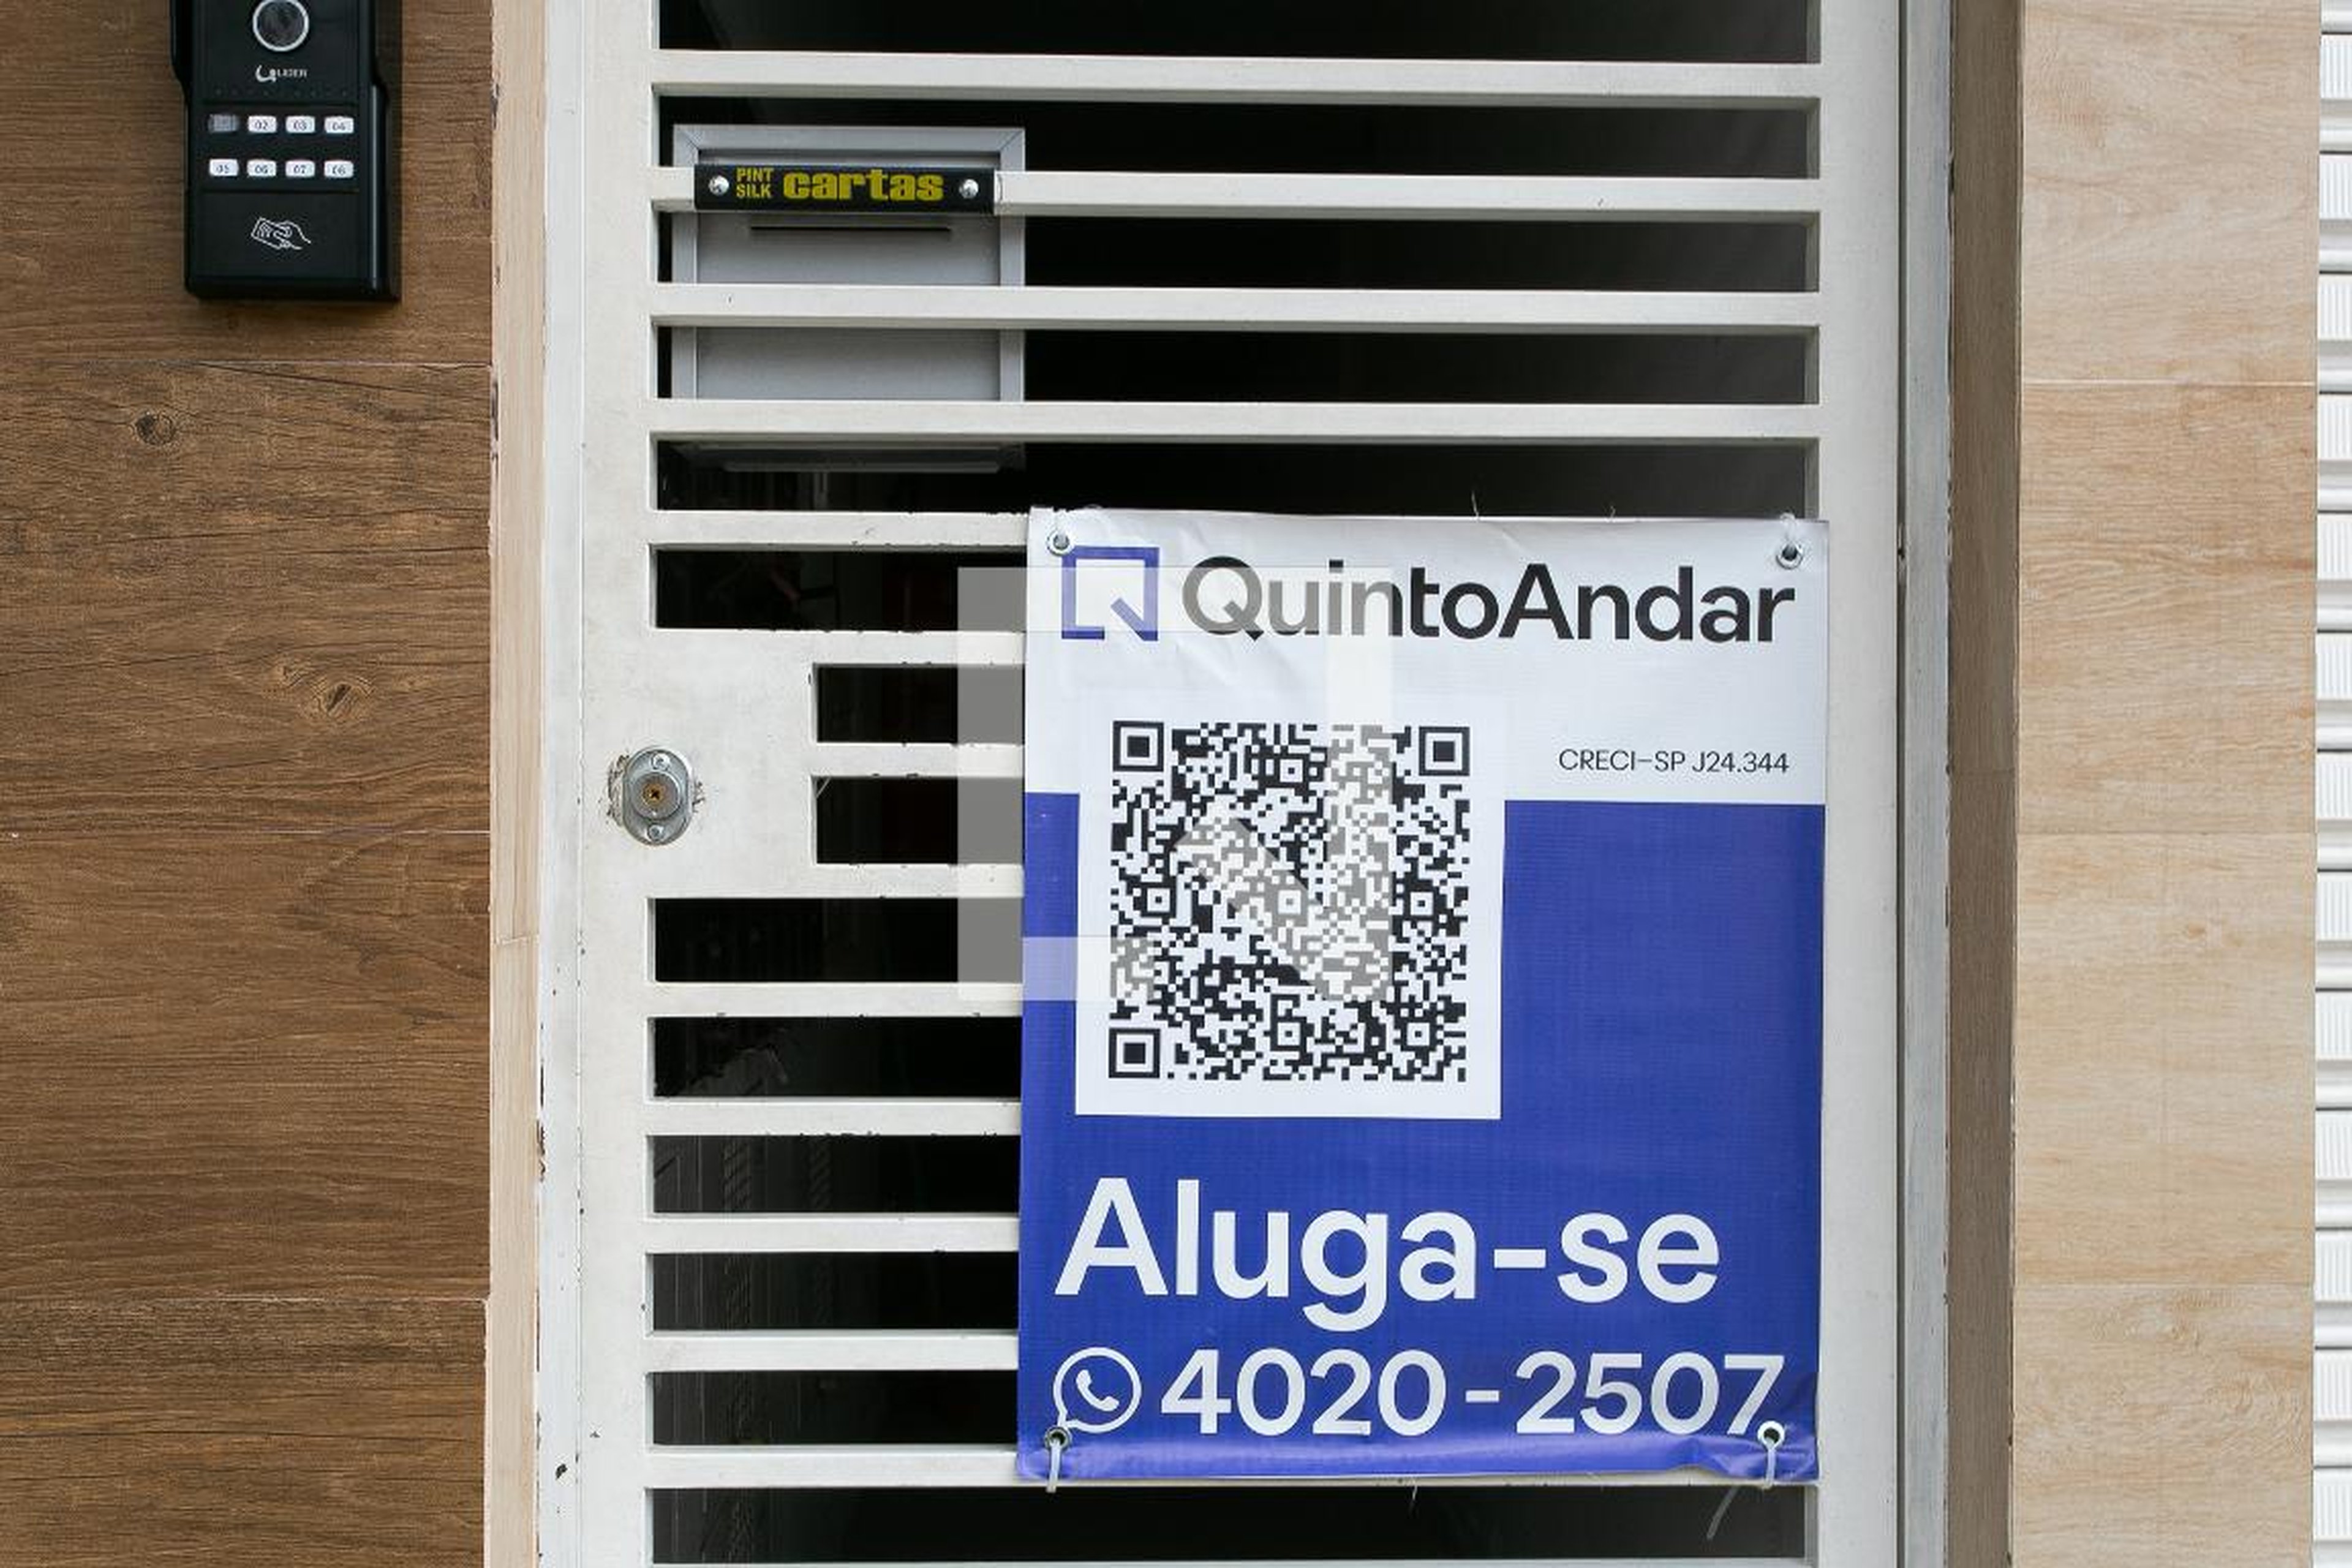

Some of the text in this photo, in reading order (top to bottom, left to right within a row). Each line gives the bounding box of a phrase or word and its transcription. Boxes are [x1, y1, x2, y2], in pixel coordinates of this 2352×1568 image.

[736, 168, 773, 181] PINT
[783, 169, 944, 201] cartas
[736, 184, 772, 198] SILK
[1182, 554, 1796, 644] QuintoAndar
[1559, 748, 1790, 773] CRECI-SP J24.344
[1055, 1177, 1720, 1332] Aluga-se
